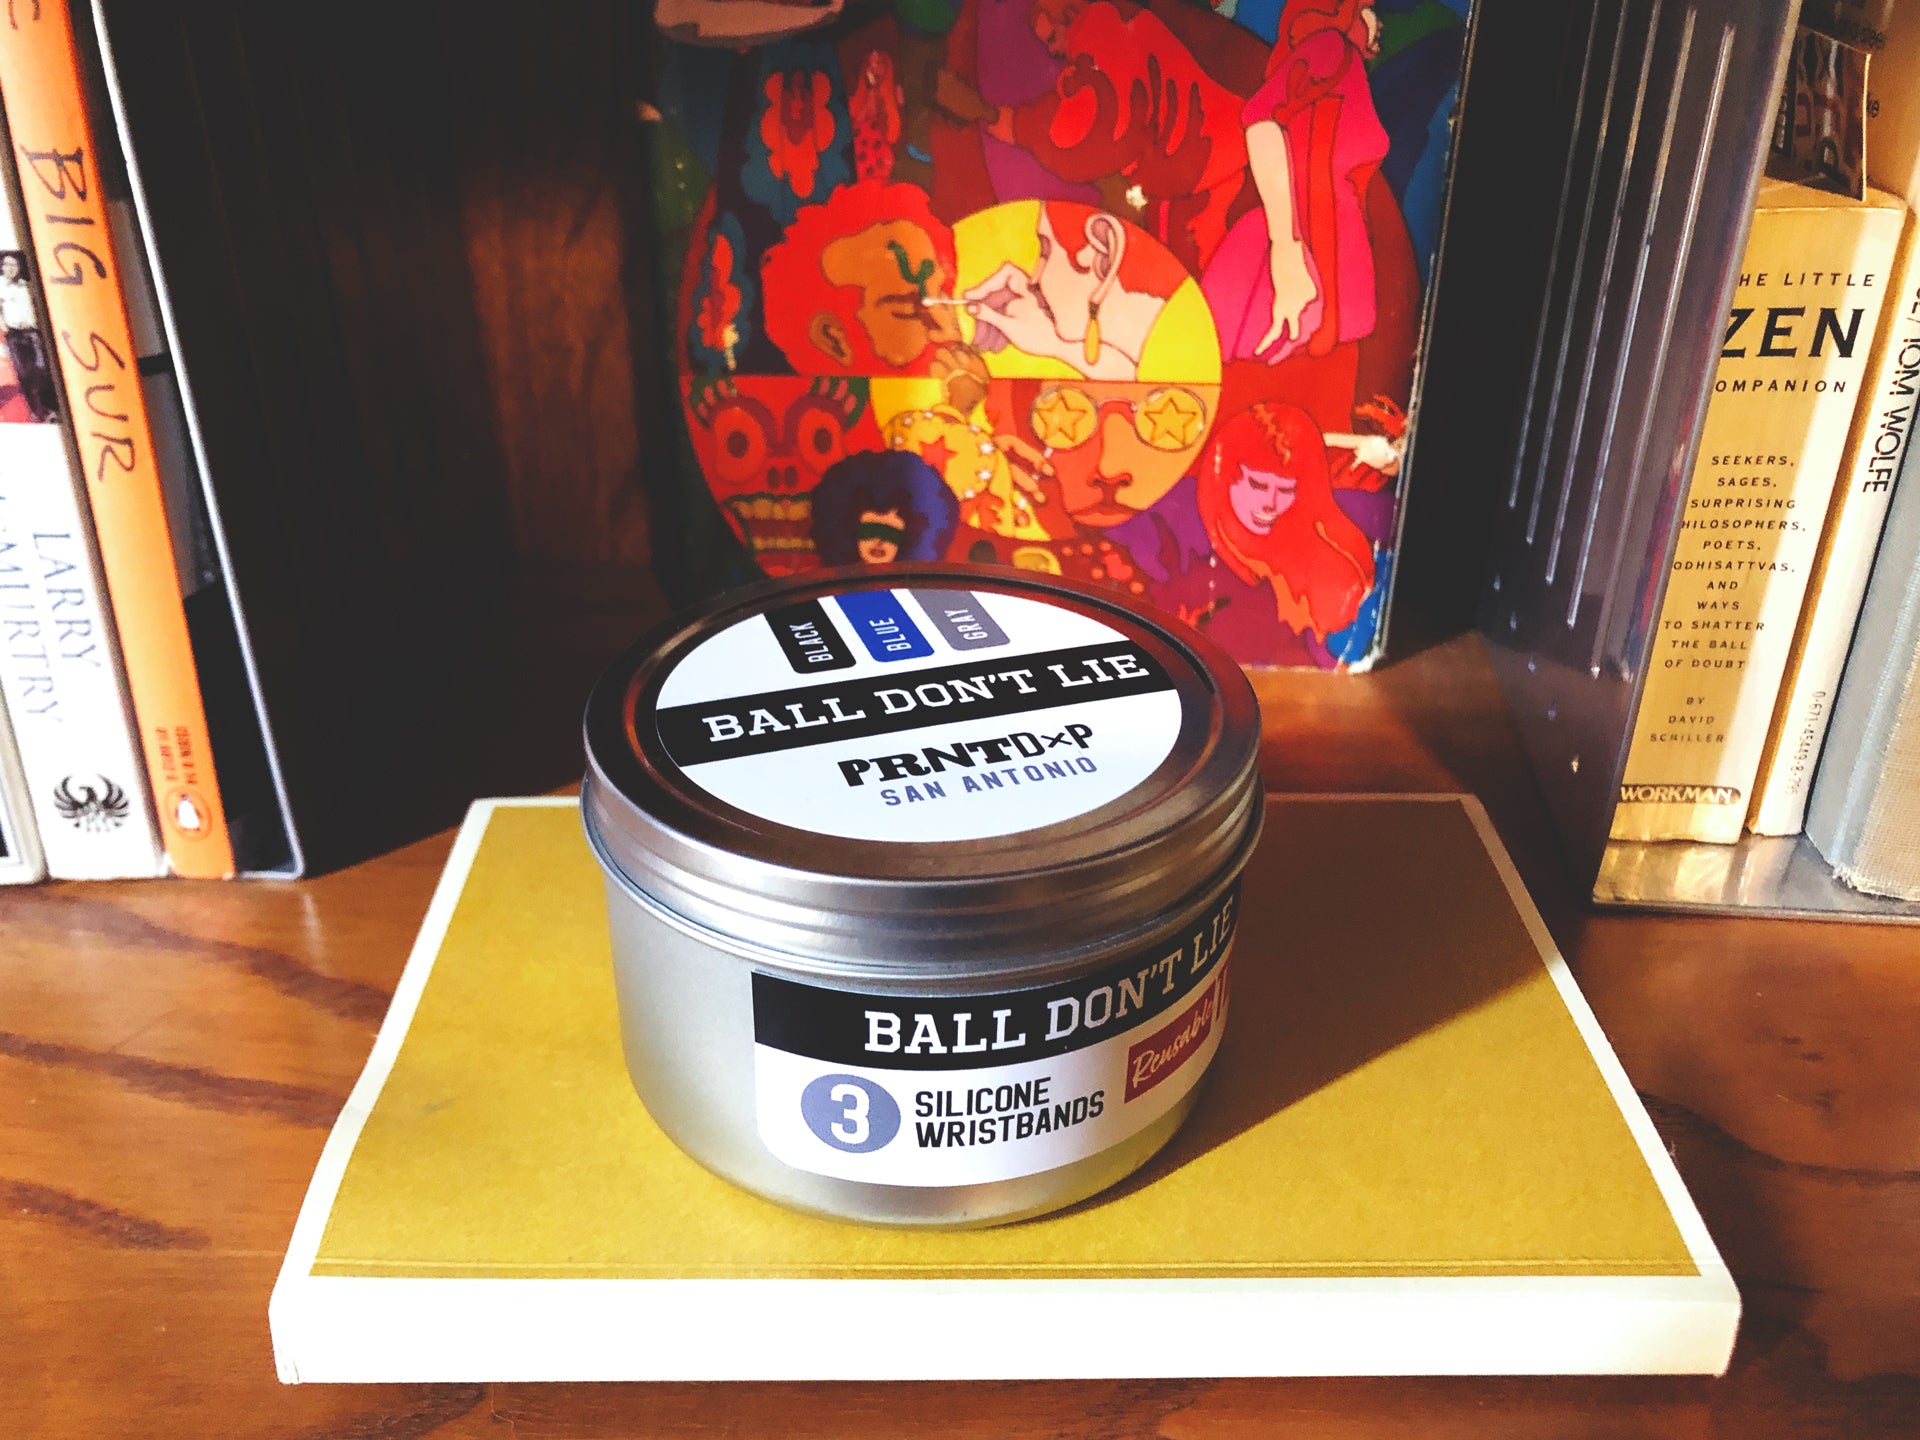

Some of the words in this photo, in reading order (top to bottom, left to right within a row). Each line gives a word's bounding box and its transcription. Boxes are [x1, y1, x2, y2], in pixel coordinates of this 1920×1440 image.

[20, 143, 107, 287] BIG
[1738, 273, 1769, 287] HE
[1783, 272, 1876, 287] LITTLE
[1720, 306, 1865, 359] ZEN
[1715, 379, 1848, 393] OMPANION
[61, 330, 136, 482] SUR
[1862, 405, 1911, 494] WOLFE
[1711, 455, 1795, 467] SEEKERS,
[1717, 477, 1777, 488] SAGES,
[1690, 498, 1797, 510] SURPRISING
[1681, 519, 1806, 532] HILOSOPHERS,
[1702, 540, 1761, 551] POETS,
[1673, 560, 1796, 573] ODHISATTVAS,
[1706, 581, 1739, 590] AND
[32, 531, 102, 669] LARRY
[1696, 600, 1740, 610] WAYS
[943, 606, 988, 641] GRAY
[1664, 620, 1683, 630] TO
[1691, 620, 1766, 631] SHATTER
[868, 615, 910, 653] BLUE
[792, 621, 834, 664] BLACK
[1671, 639, 1700, 649] THE
[1709, 639, 1748, 650] BALL
[1664, 659, 1684, 669] OF
[1691, 659, 1746, 669] DOUBT
[701, 696, 867, 743] BALL
[873, 669, 1036, 715] DON'T
[1052, 653, 1151, 687] LIE
[1686, 696, 1706, 706] BY
[1668, 715, 1715, 725] DAVID
[1650, 733, 1725, 743] SCHILLER
[880, 780, 947, 808] SAN
[961, 755, 1099, 796] ANTONIO
[1620, 785, 1733, 803] WORKMAN
[863, 1008, 1027, 1056] BALL
[1045, 947, 1184, 1043] DON'T
[1190, 895, 1235, 975] LIE
[1131, 996, 1215, 1089] Reusable
[915, 1076, 1053, 1119] SILICONE
[829, 1083, 871, 1145] 3
[915, 1090, 1106, 1149] WRISTBANDS
